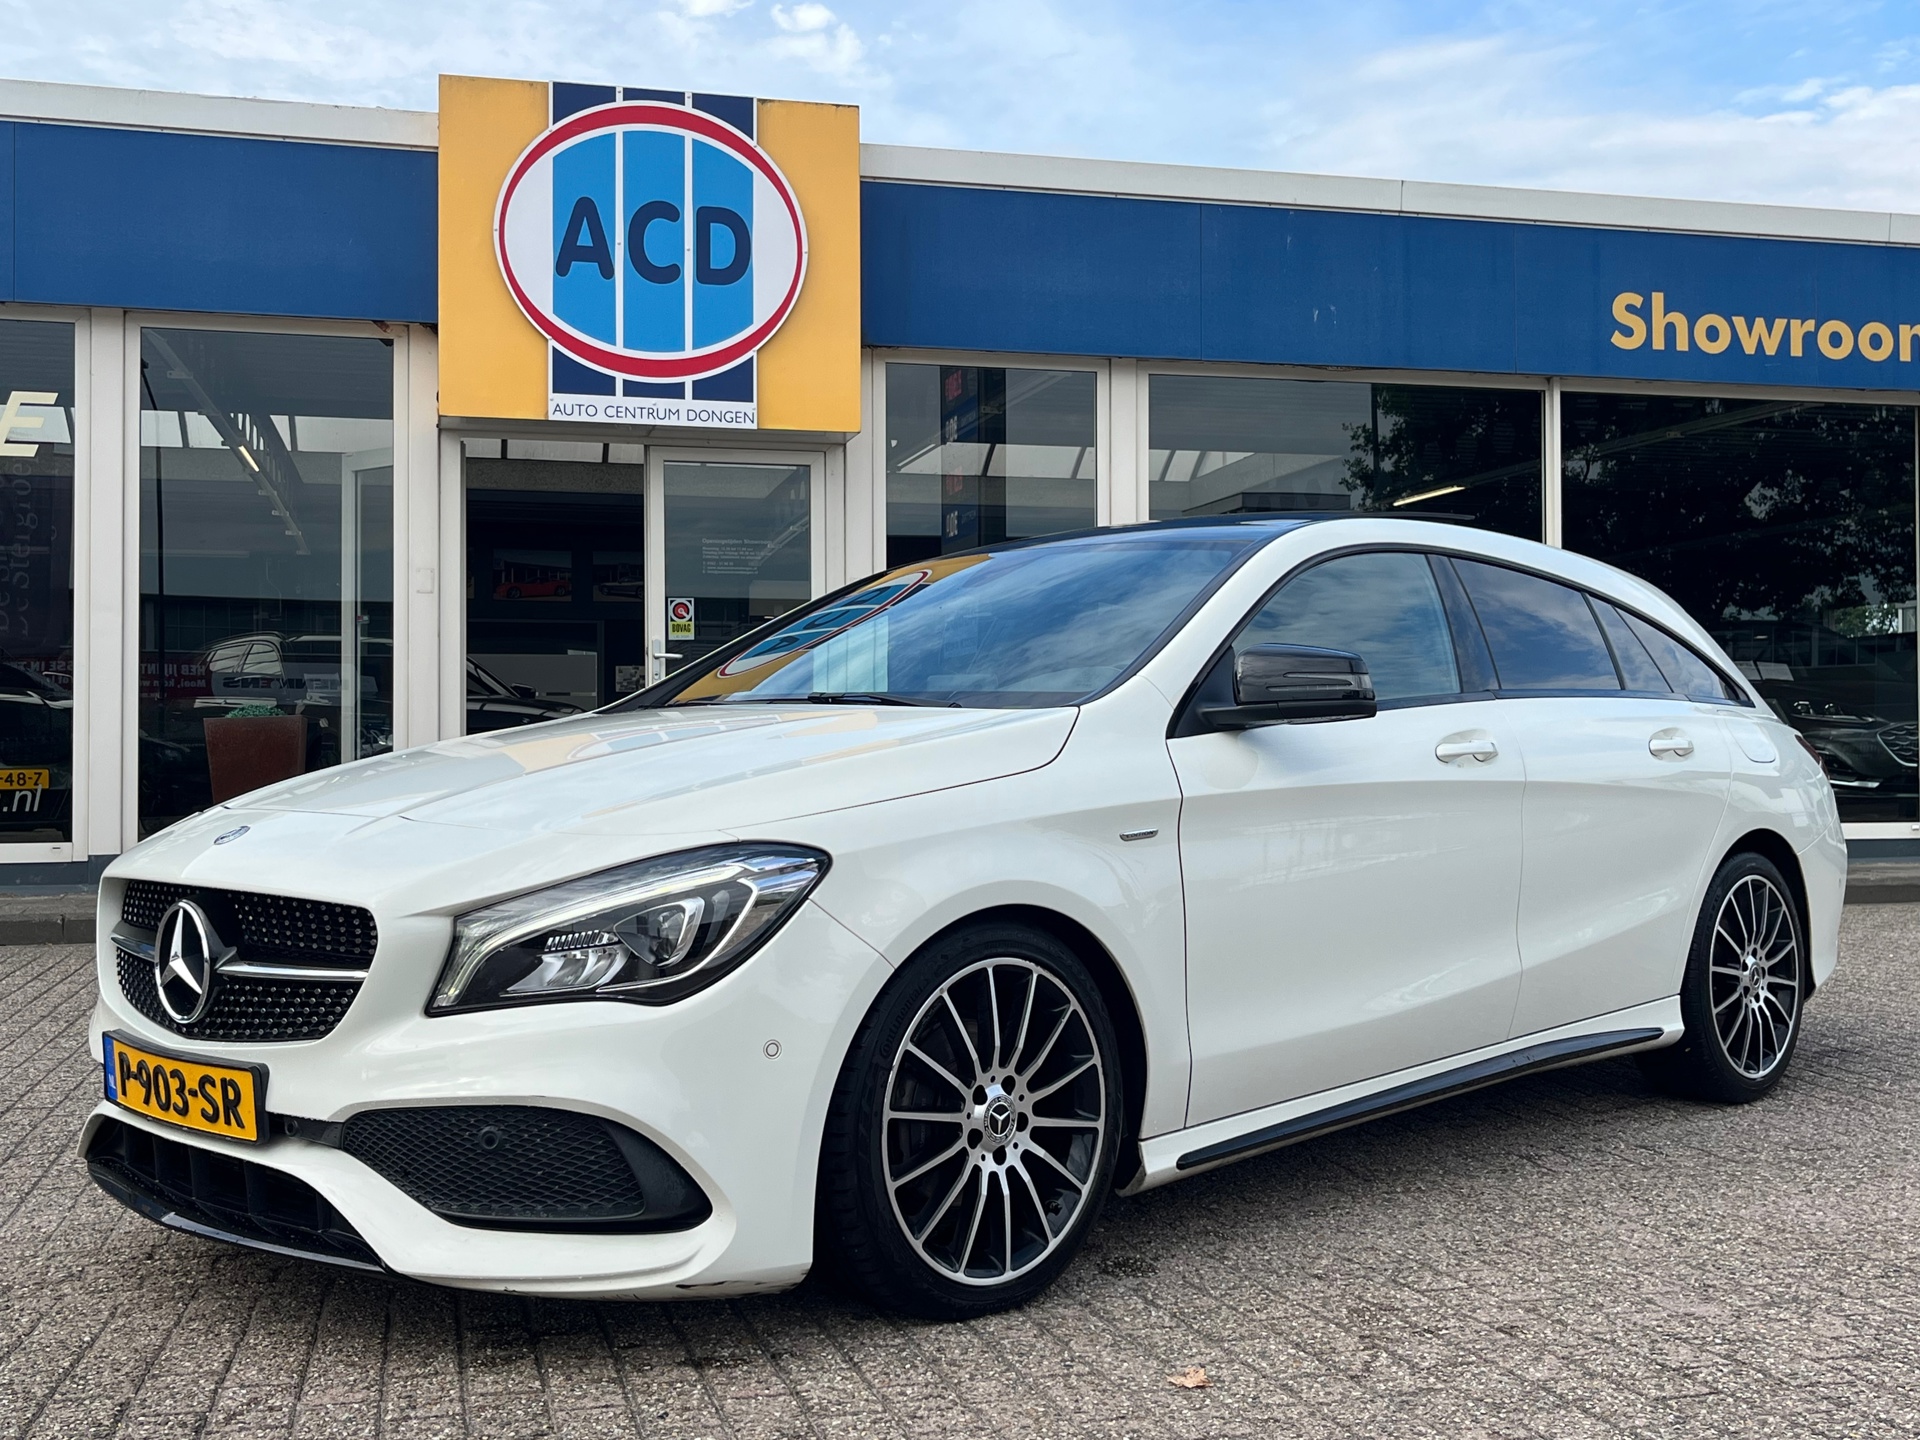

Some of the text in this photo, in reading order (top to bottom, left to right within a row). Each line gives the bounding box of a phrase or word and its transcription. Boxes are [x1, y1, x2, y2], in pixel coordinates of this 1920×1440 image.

[555, 196, 752, 286] ACD
[552, 403, 755, 425] AUTO CENTRUM DONGEN
[672, 623, 691, 633] BOVAG
[118, 1051, 245, 1129] P-903-SR
